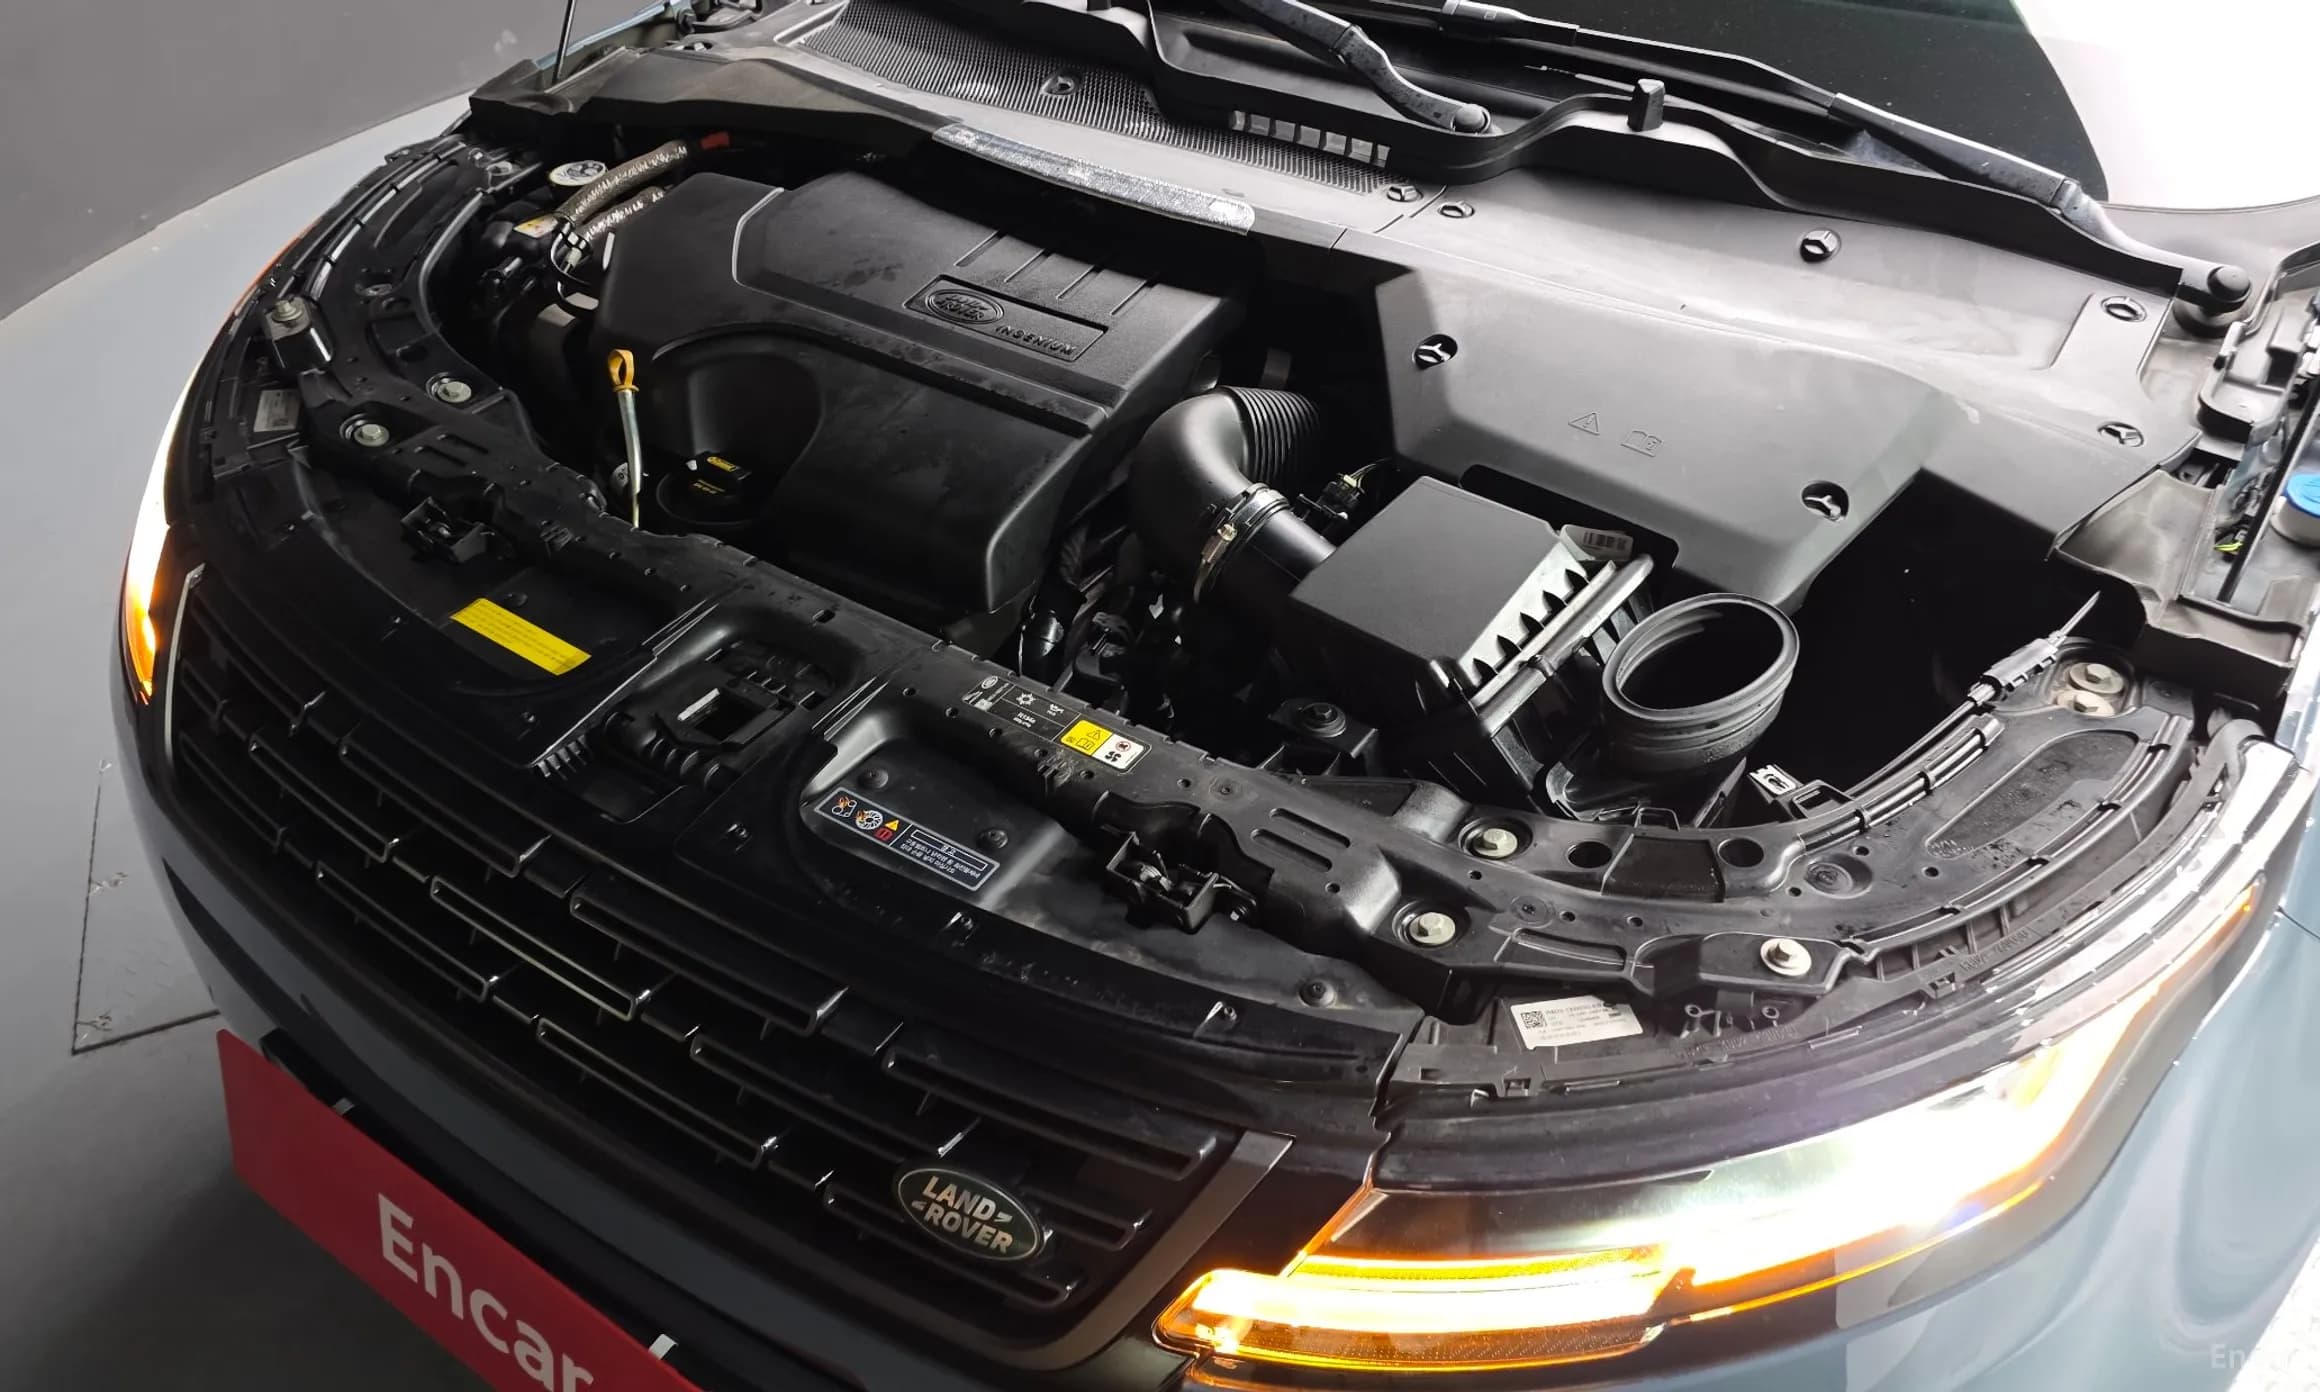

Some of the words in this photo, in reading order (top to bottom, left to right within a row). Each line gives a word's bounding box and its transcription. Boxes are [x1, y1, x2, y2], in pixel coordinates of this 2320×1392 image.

[995, 324, 1077, 355] INGENIUM
[922, 1176, 997, 1221] LAND
[923, 1202, 1014, 1254] ROVER
[378, 1192, 595, 1392] Encar
